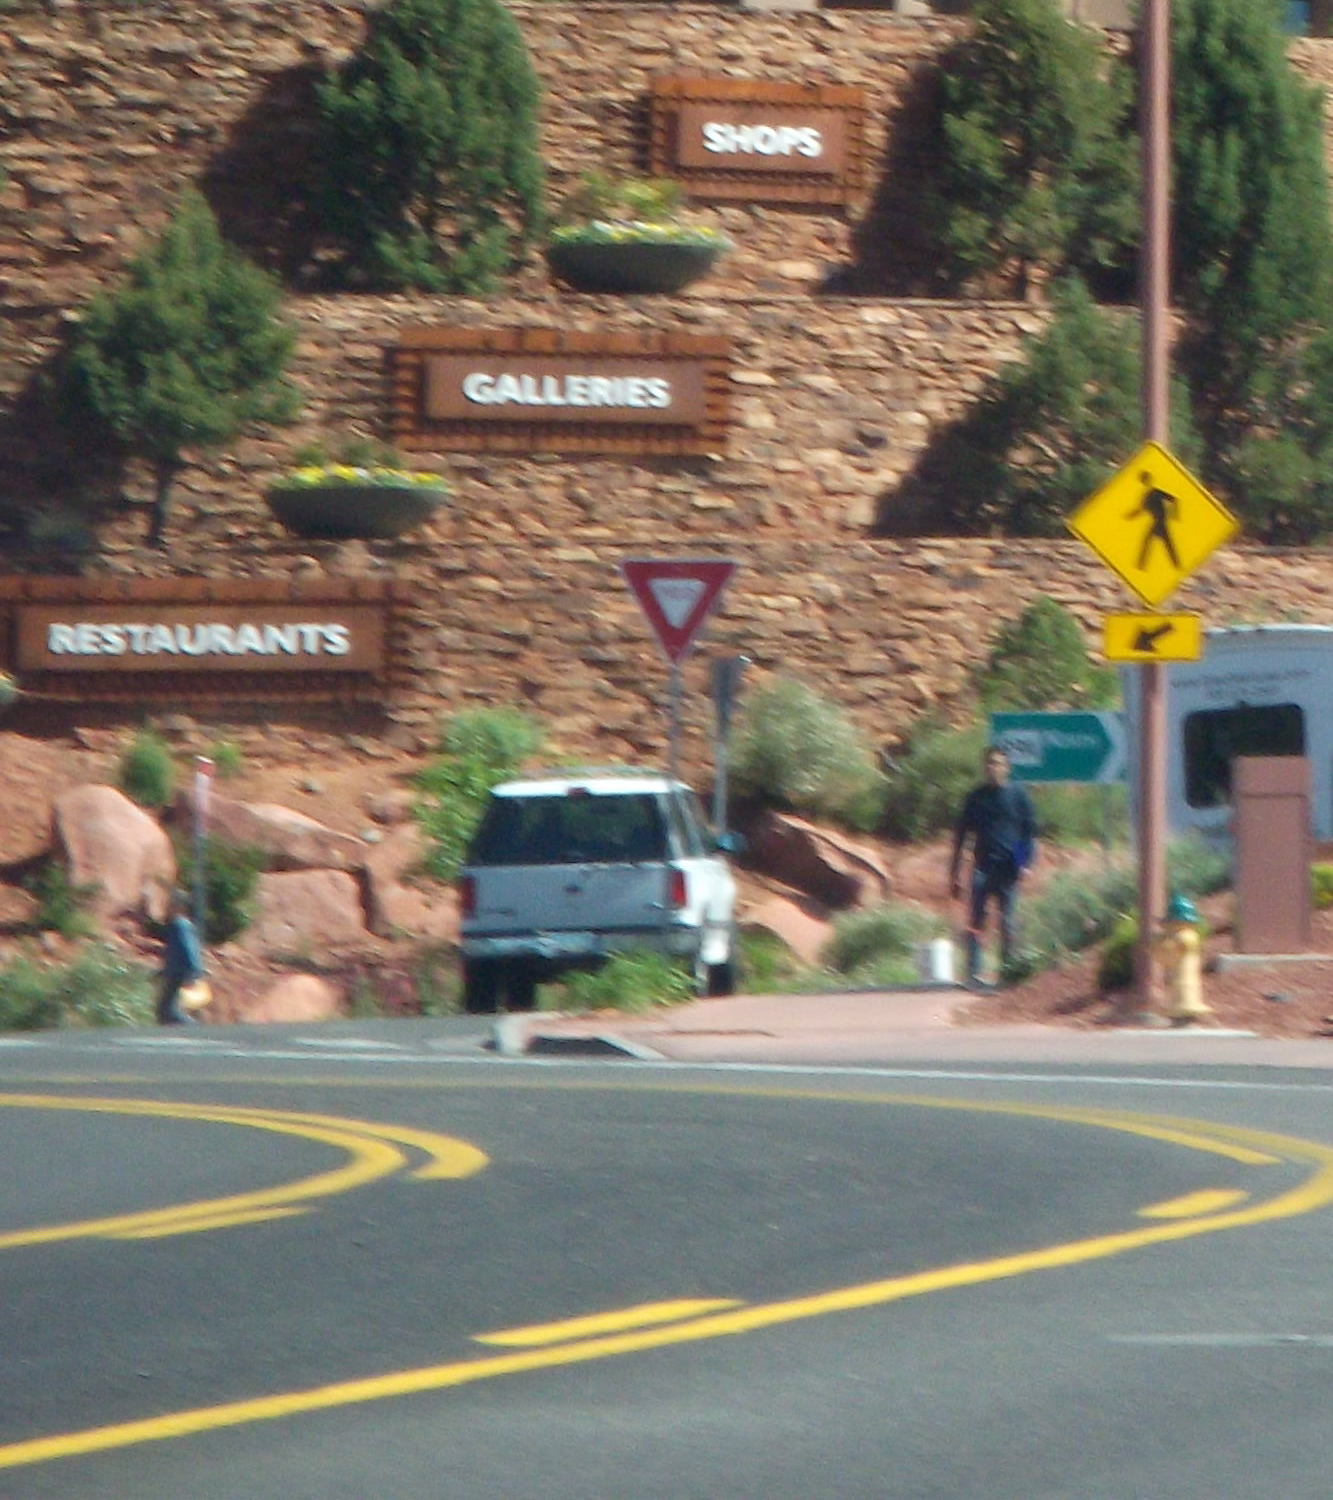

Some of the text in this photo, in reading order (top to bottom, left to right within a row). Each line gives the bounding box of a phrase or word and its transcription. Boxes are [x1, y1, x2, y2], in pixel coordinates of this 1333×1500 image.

[702, 122, 823, 157] SHOPS
[462, 372, 672, 408] GALLERIES
[48, 622, 351, 656] RESTAURANTS
